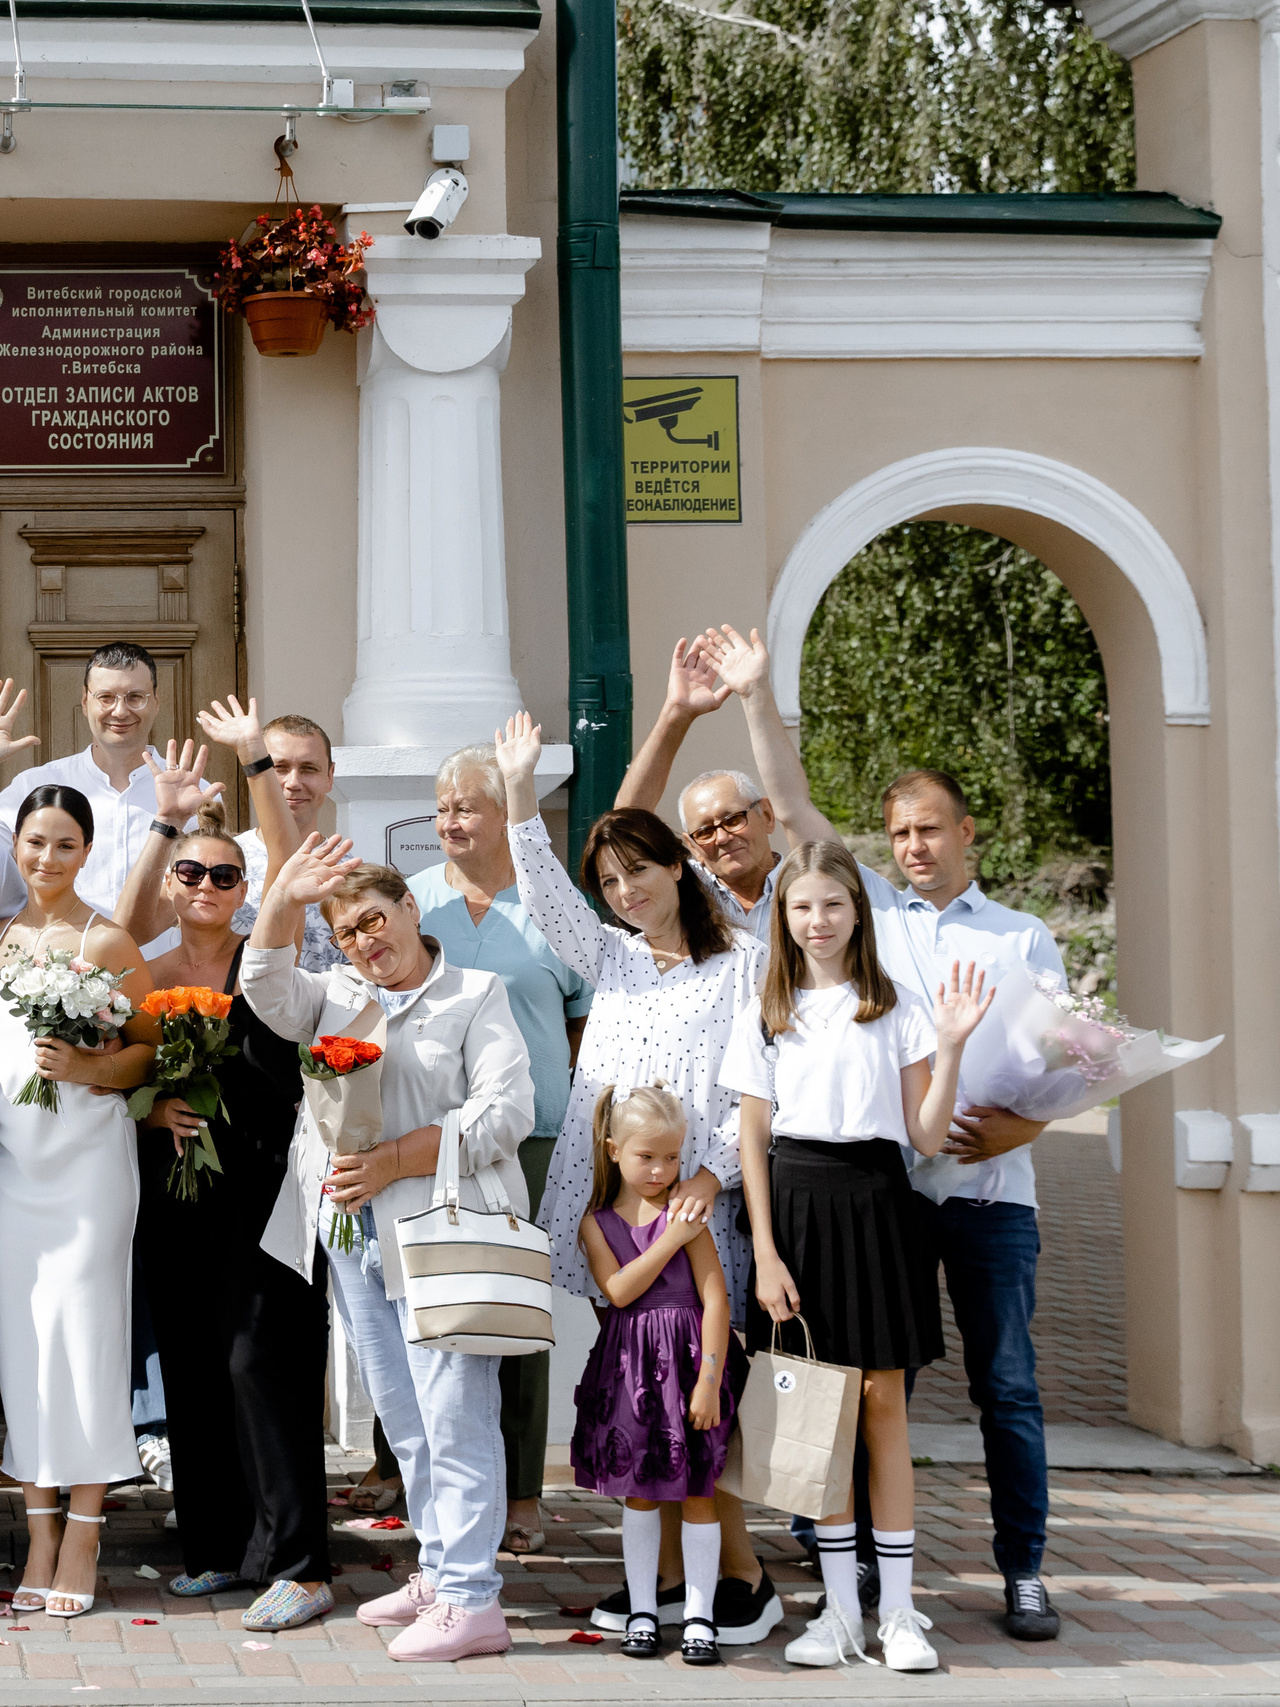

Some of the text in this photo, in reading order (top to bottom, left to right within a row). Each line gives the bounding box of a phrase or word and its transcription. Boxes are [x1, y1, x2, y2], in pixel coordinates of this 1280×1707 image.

[27, 286, 182, 302] Витебский городской
[12, 303, 197, 318] исполнительный комитет
[41, 325, 160, 342] Администрация
[151, 342, 203, 360] района
[62, 360, 141, 375] г.Витебска
[1, 386, 199, 407] ОТДЕЛ ЗАПИСИ АКТОВ
[31, 409, 170, 430] ГРАЖДАНСКОГО
[48, 432, 154, 450] СОСТОЯНИЯ
[631, 460, 731, 474] ТЕРРИТОРИИ
[635, 477, 700, 496] ВЕДЁТСЯ
[626, 498, 736, 514] ЕОНАБЛЮДЕНИЕ
